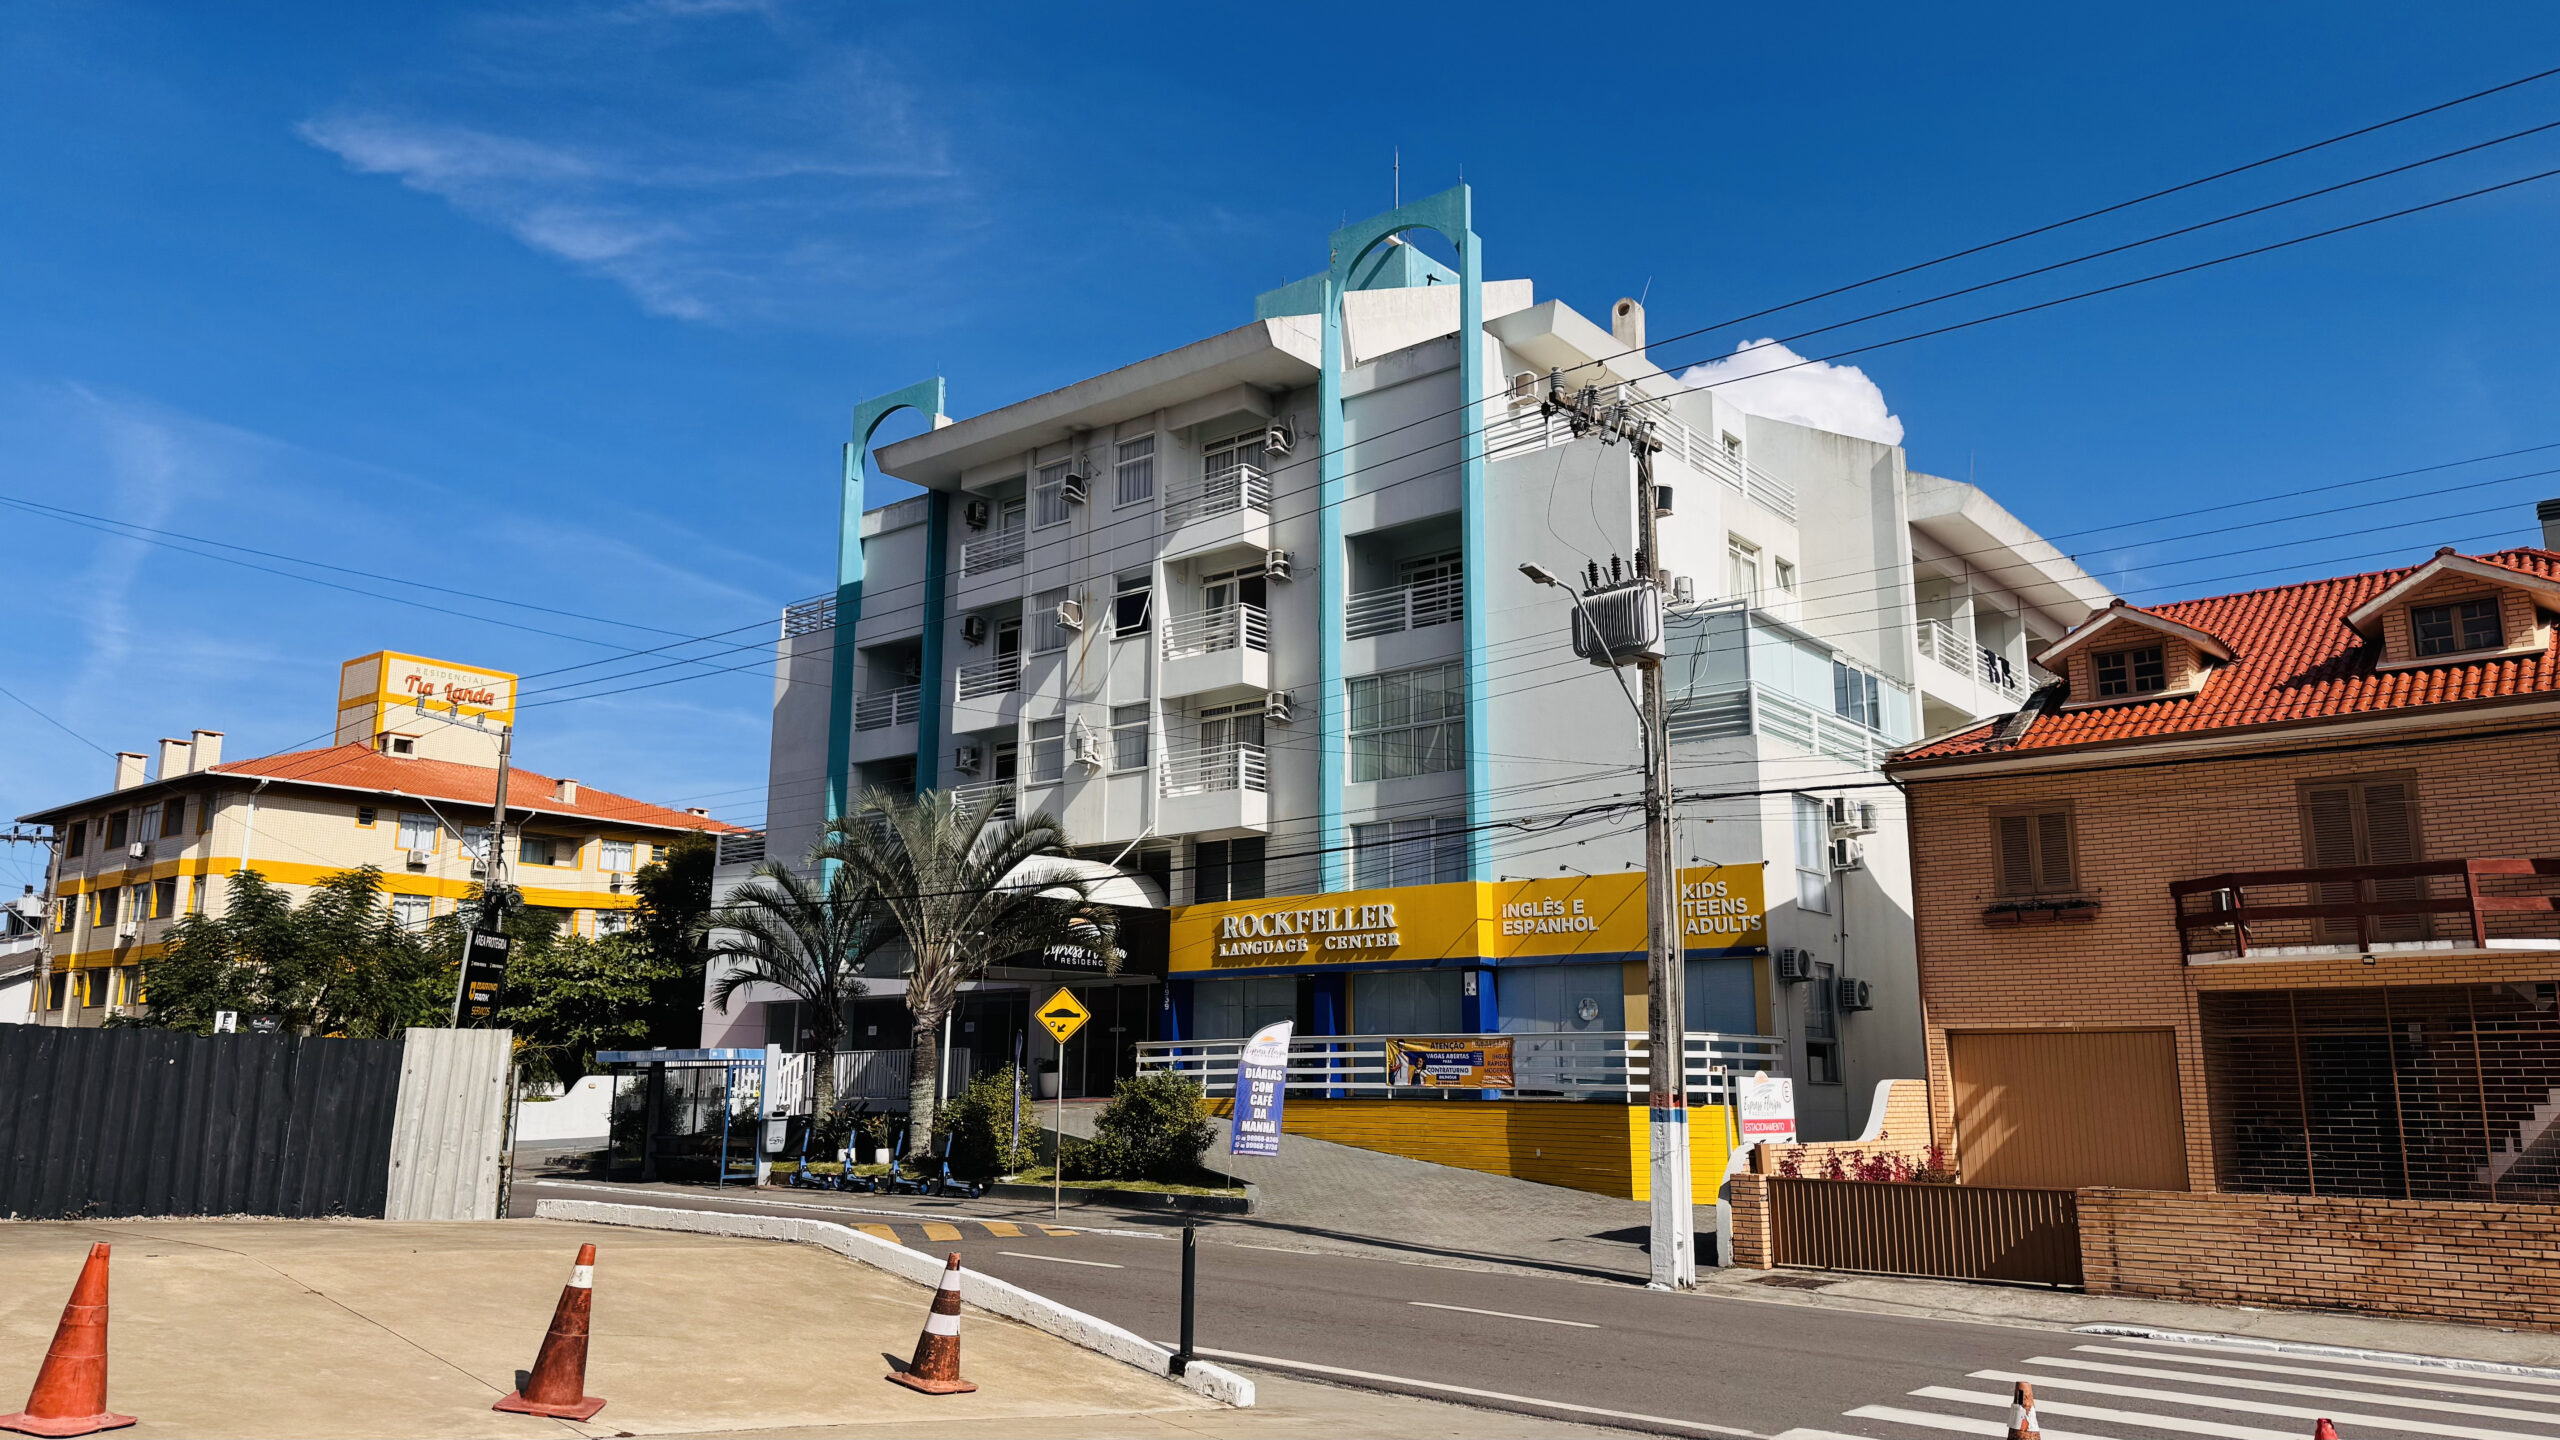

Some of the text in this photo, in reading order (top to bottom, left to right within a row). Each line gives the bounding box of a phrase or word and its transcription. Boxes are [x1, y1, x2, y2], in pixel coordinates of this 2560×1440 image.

[416, 666, 485, 686] RESIDENCIAL
[444, 682, 495, 706] Landa
[1683, 880, 1728, 900] KIDS
[1502, 896, 1584, 918] INGLÊS E
[1684, 897, 1748, 917] TEENS
[1222, 903, 1398, 939] ROCKFELLER
[1502, 916, 1599, 936] ESPANHOL
[1685, 914, 1763, 936] ADULTS
[1219, 932, 1401, 957] LANGUAGE CENTER
[1061, 957, 1107, 967] RESIDENC
[1430, 1040, 1465, 1051] ATENÇÃO
[1426, 1053, 1445, 1061] VAGAS
[1446, 1053, 1470, 1061] ABERTAS
[1245, 1066, 1283, 1081] DIÁRIAS
[1252, 1081, 1274, 1094] COM
[1250, 1094, 1273, 1107] CAFÉ
[1254, 1108, 1267, 1120] DA
[1242, 1120, 1276, 1134] MANHÃ
